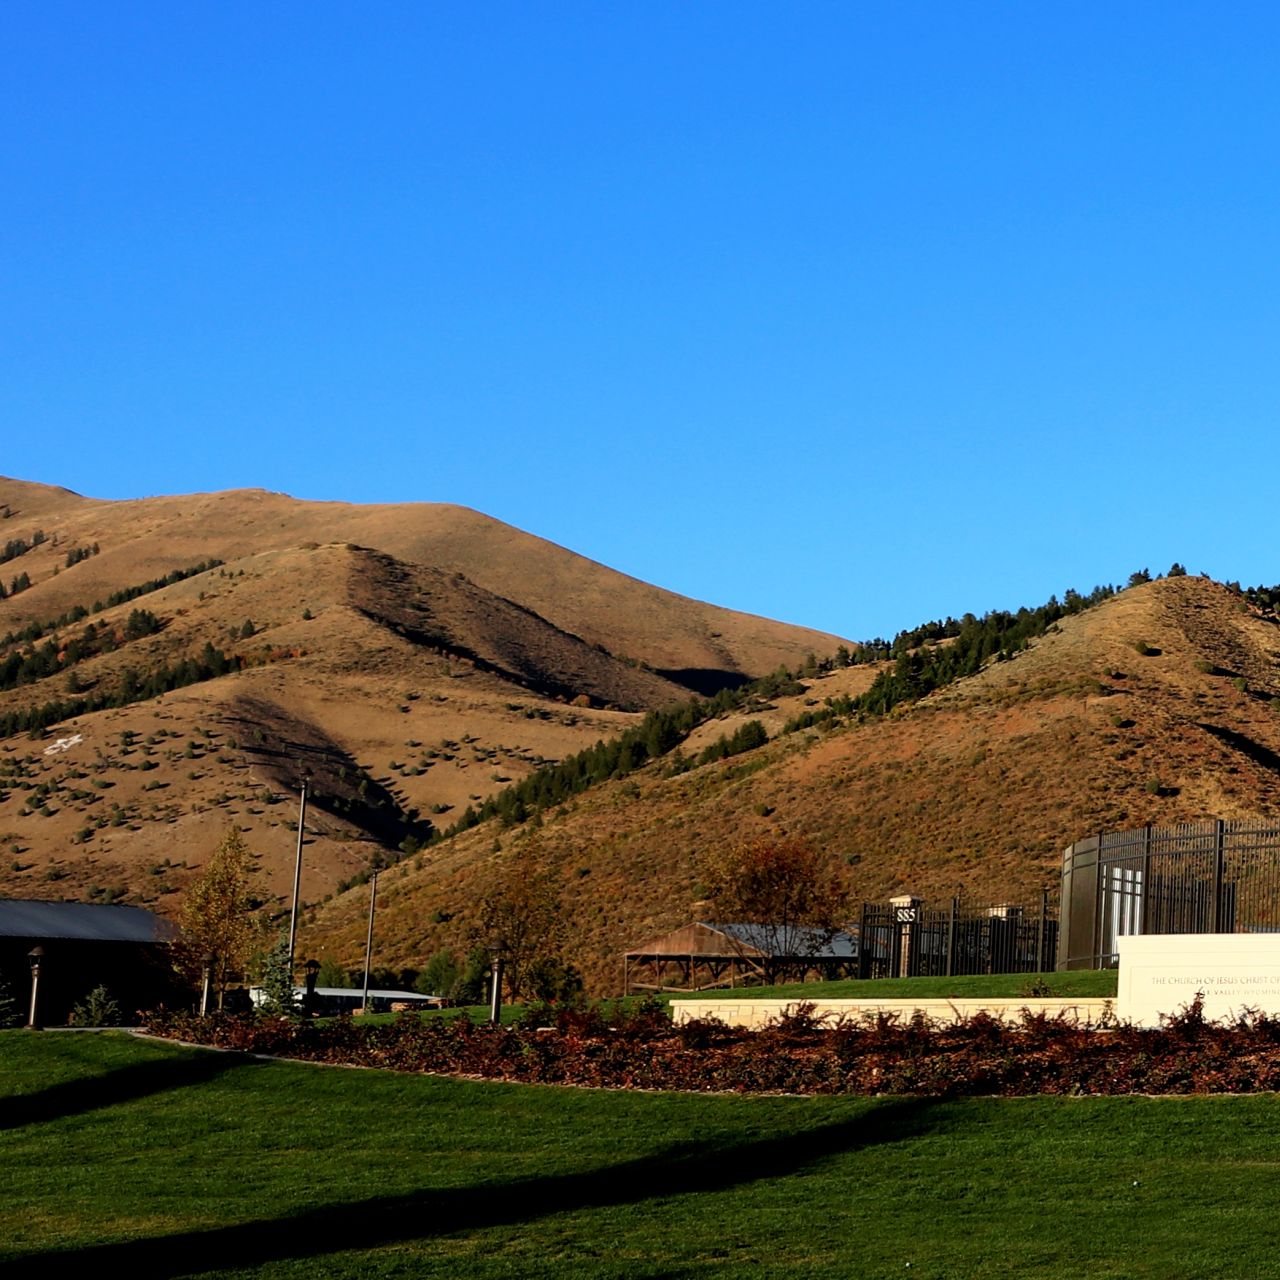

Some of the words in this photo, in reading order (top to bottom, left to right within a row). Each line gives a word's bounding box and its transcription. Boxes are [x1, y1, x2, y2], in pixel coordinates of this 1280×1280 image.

[897, 908, 916, 922] 885
[1151, 976, 1167, 985] THE
[1168, 976, 1202, 985] CHURCH
[1203, 976, 1215, 985] OF
[1216, 976, 1239, 985] JESUS
[1239, 976, 1268, 985] CHRIST
[1269, 976, 1280, 985] OF
[1214, 988, 1240, 996] VALLEY
